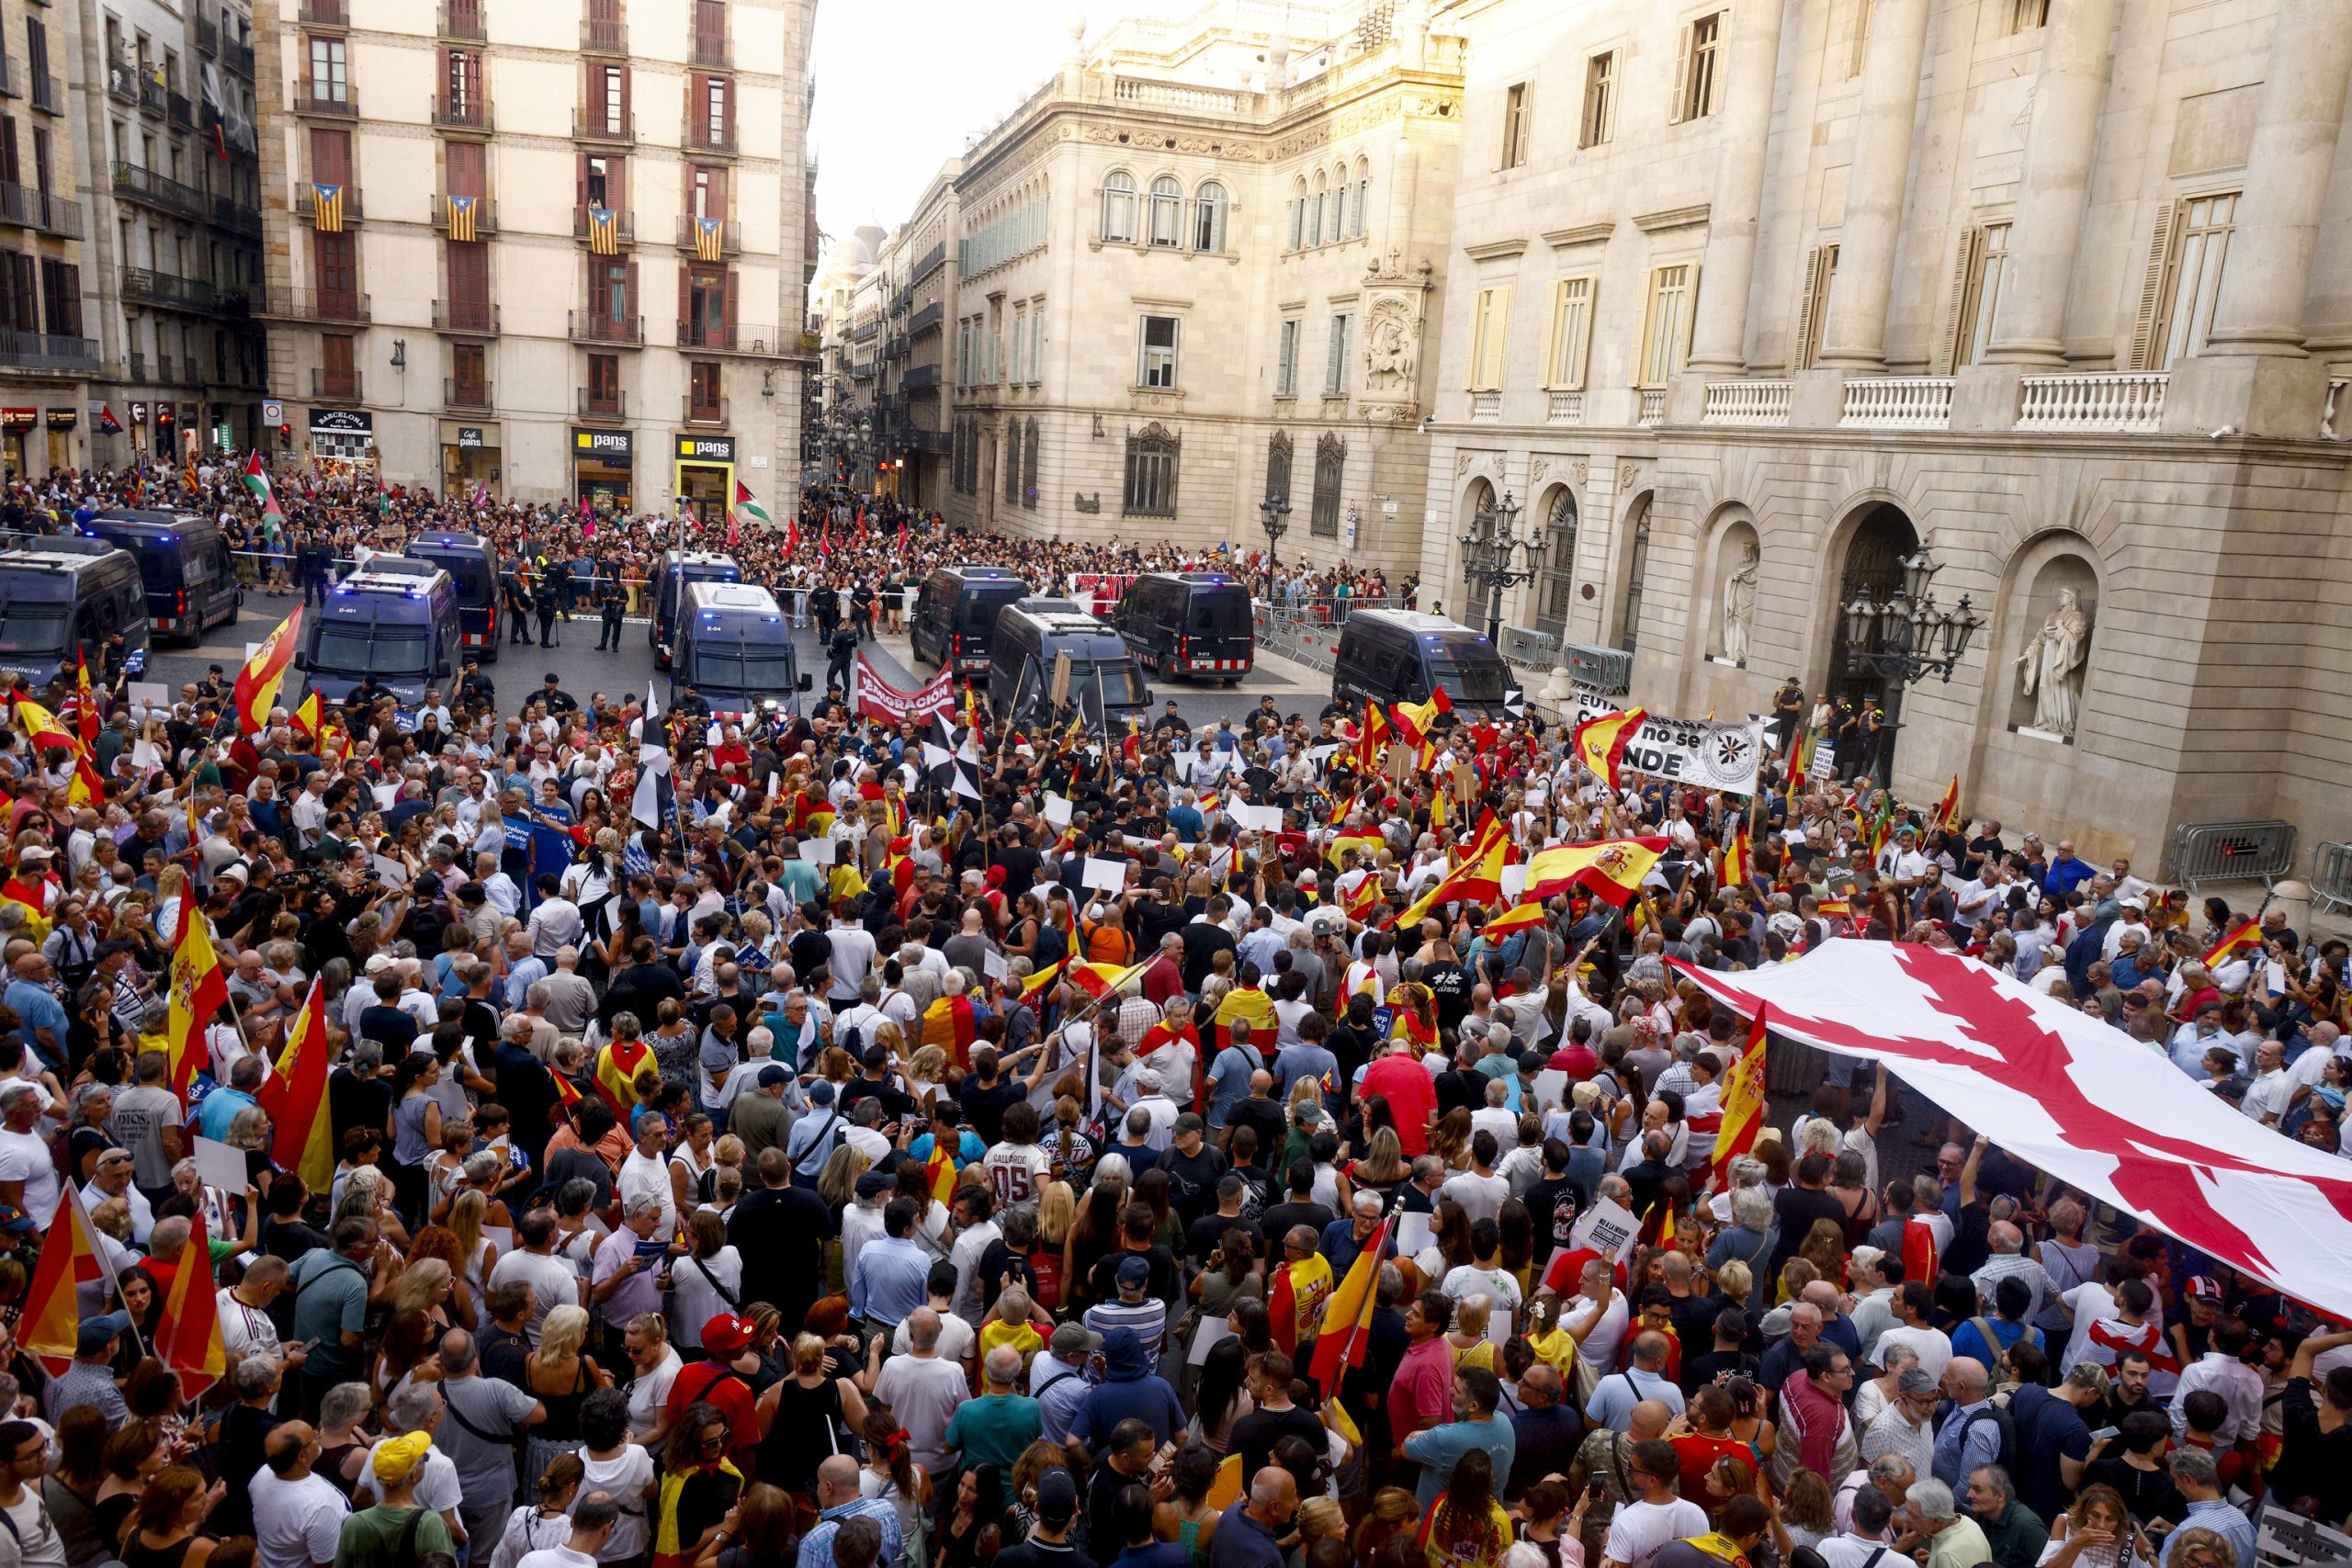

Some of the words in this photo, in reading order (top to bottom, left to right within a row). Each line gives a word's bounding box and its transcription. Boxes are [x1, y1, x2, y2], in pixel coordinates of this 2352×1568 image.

[318, 412, 364, 428] BARCELONA
[459, 438, 481, 447] pans
[594, 434, 627, 448] pans
[696, 441, 729, 455] pans
[1348, 682, 1363, 695] mossos
[1642, 727, 1670, 743] no
[1676, 734, 1701, 749] se
[1623, 745, 1683, 777] NDE
[1815, 762, 1829, 771] VENDE
[993, 1155, 1027, 1164] GALLARDO
[993, 1166, 1029, 1202] 05
[1554, 1188, 1574, 1201] MALTA
[1609, 1223, 1615, 1231] LA
